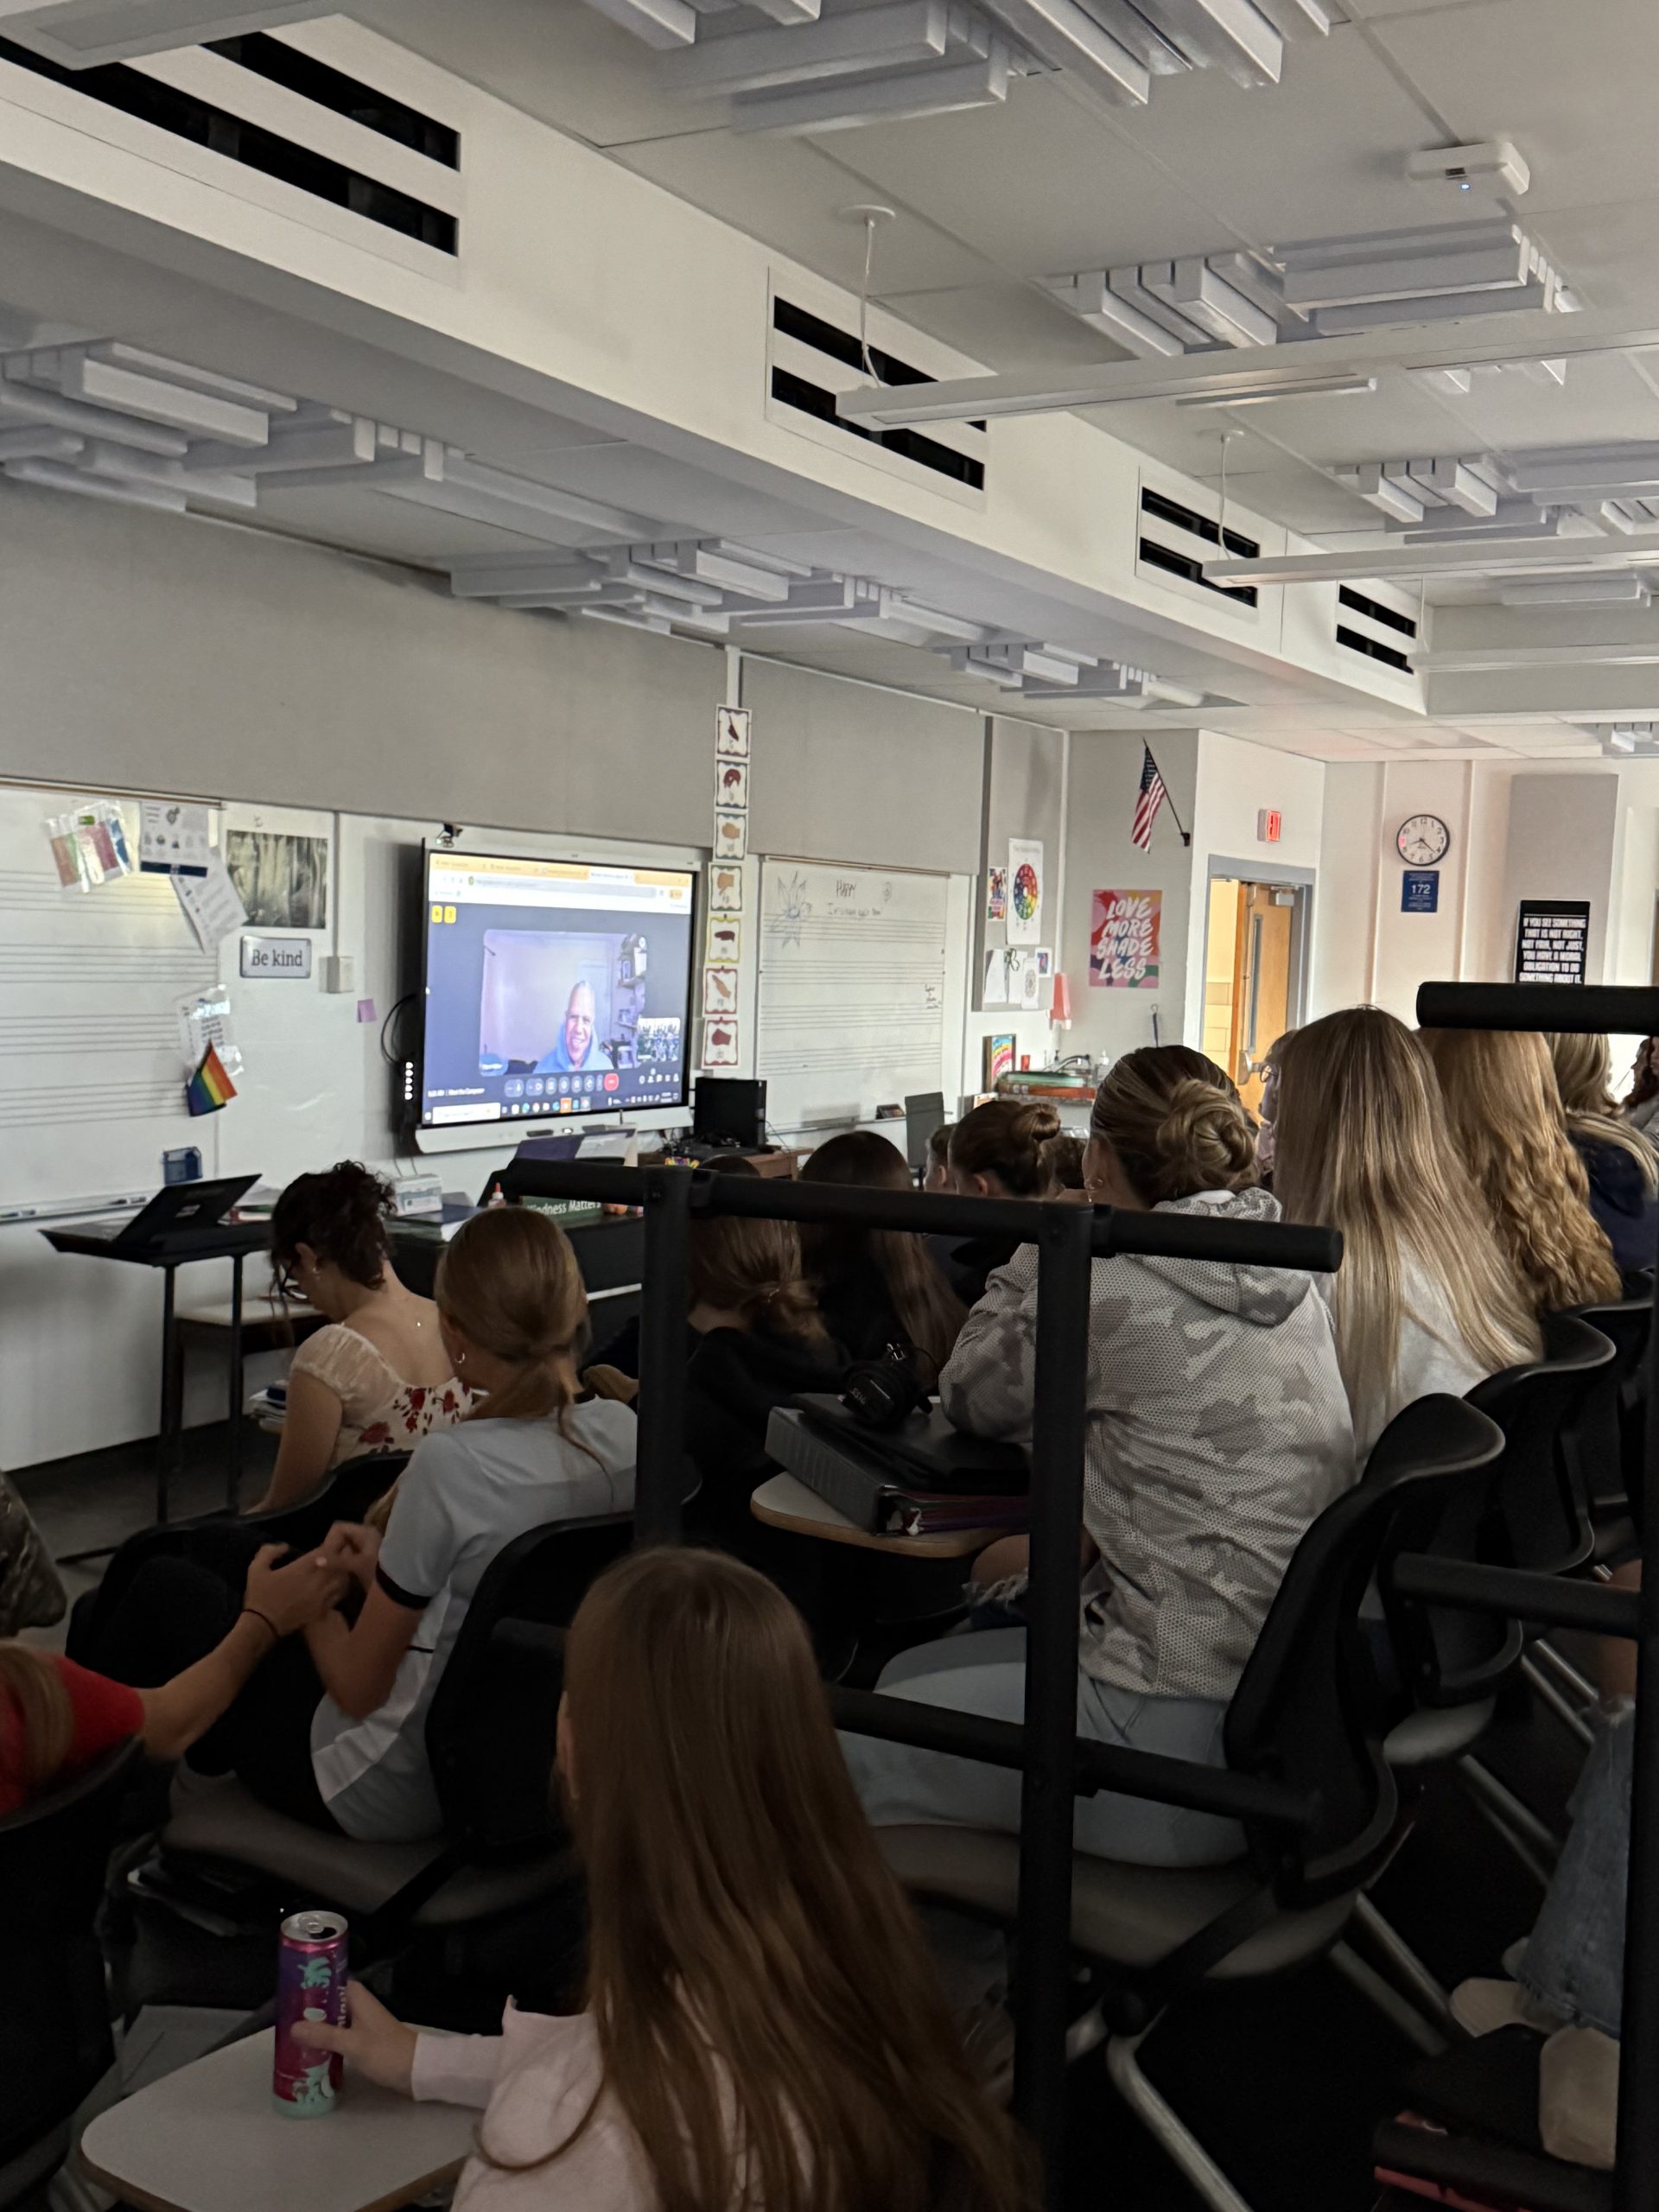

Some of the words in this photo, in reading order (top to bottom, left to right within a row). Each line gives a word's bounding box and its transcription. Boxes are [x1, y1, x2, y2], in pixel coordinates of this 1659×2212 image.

[1411, 884, 1432, 894] 172
[1106, 897, 1152, 919] LOVE
[1102, 918, 1154, 938] MORE
[1552, 918, 1586, 928] SOMETHING
[1524, 928, 1540, 938] THAT
[1548, 929, 1562, 938] NOT
[1096, 936, 1154, 960] SHADE
[1522, 939, 1535, 949] NOT
[1552, 940, 1566, 950] NOT
[251, 949, 269, 966] Be
[272, 949, 303, 967] kind
[1523, 950, 1535, 960] YOU
[1098, 957, 1147, 980] LESS
[1560, 962, 1569, 972] TO
[1570, 963, 1580, 973] DO
[1519, 972, 1554, 982] SOMETHING
